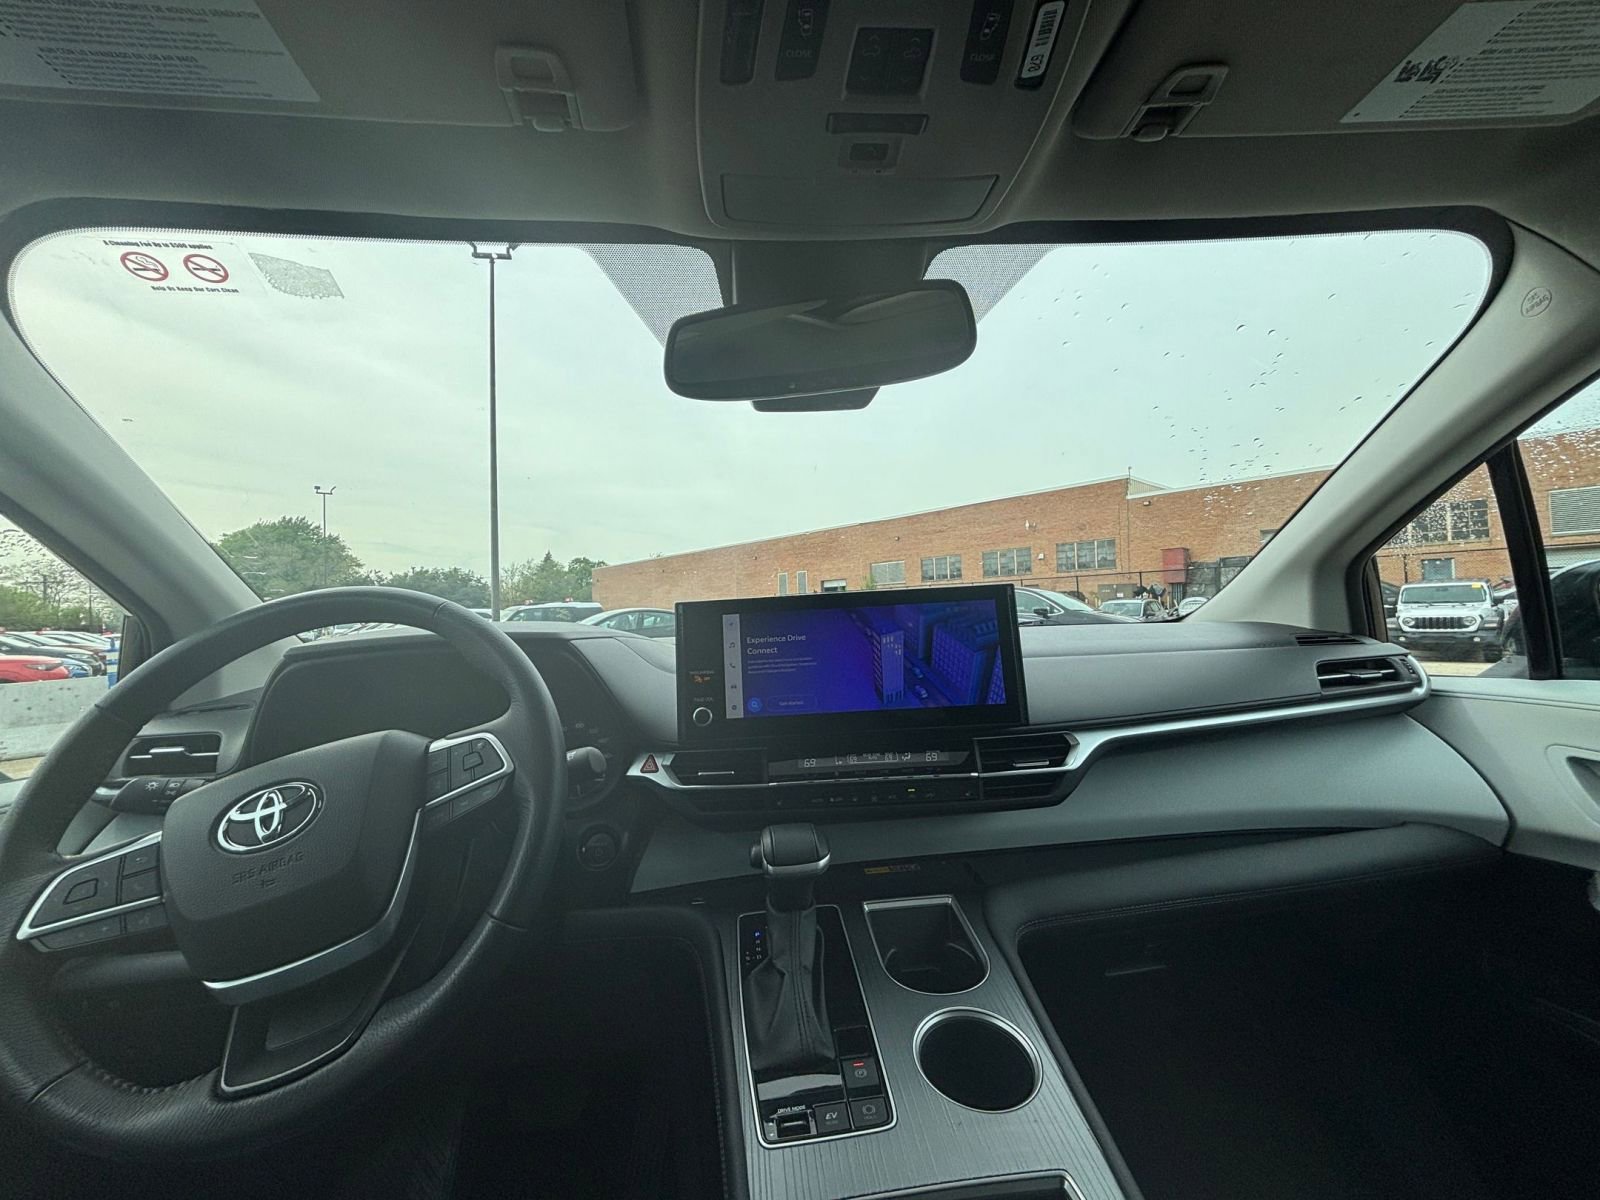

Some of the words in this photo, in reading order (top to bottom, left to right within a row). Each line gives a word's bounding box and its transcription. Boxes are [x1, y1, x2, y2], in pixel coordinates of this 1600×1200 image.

[786, 49, 813, 58] CLOSE
[746, 635, 786, 645] Experience
[787, 634, 807, 642] Drive
[747, 647, 778, 655] Connect
[926, 752, 938, 762] 69
[804, 758, 816, 768] 69
[791, 1104, 806, 1112] MODE
[825, 1112, 838, 1120] EV
